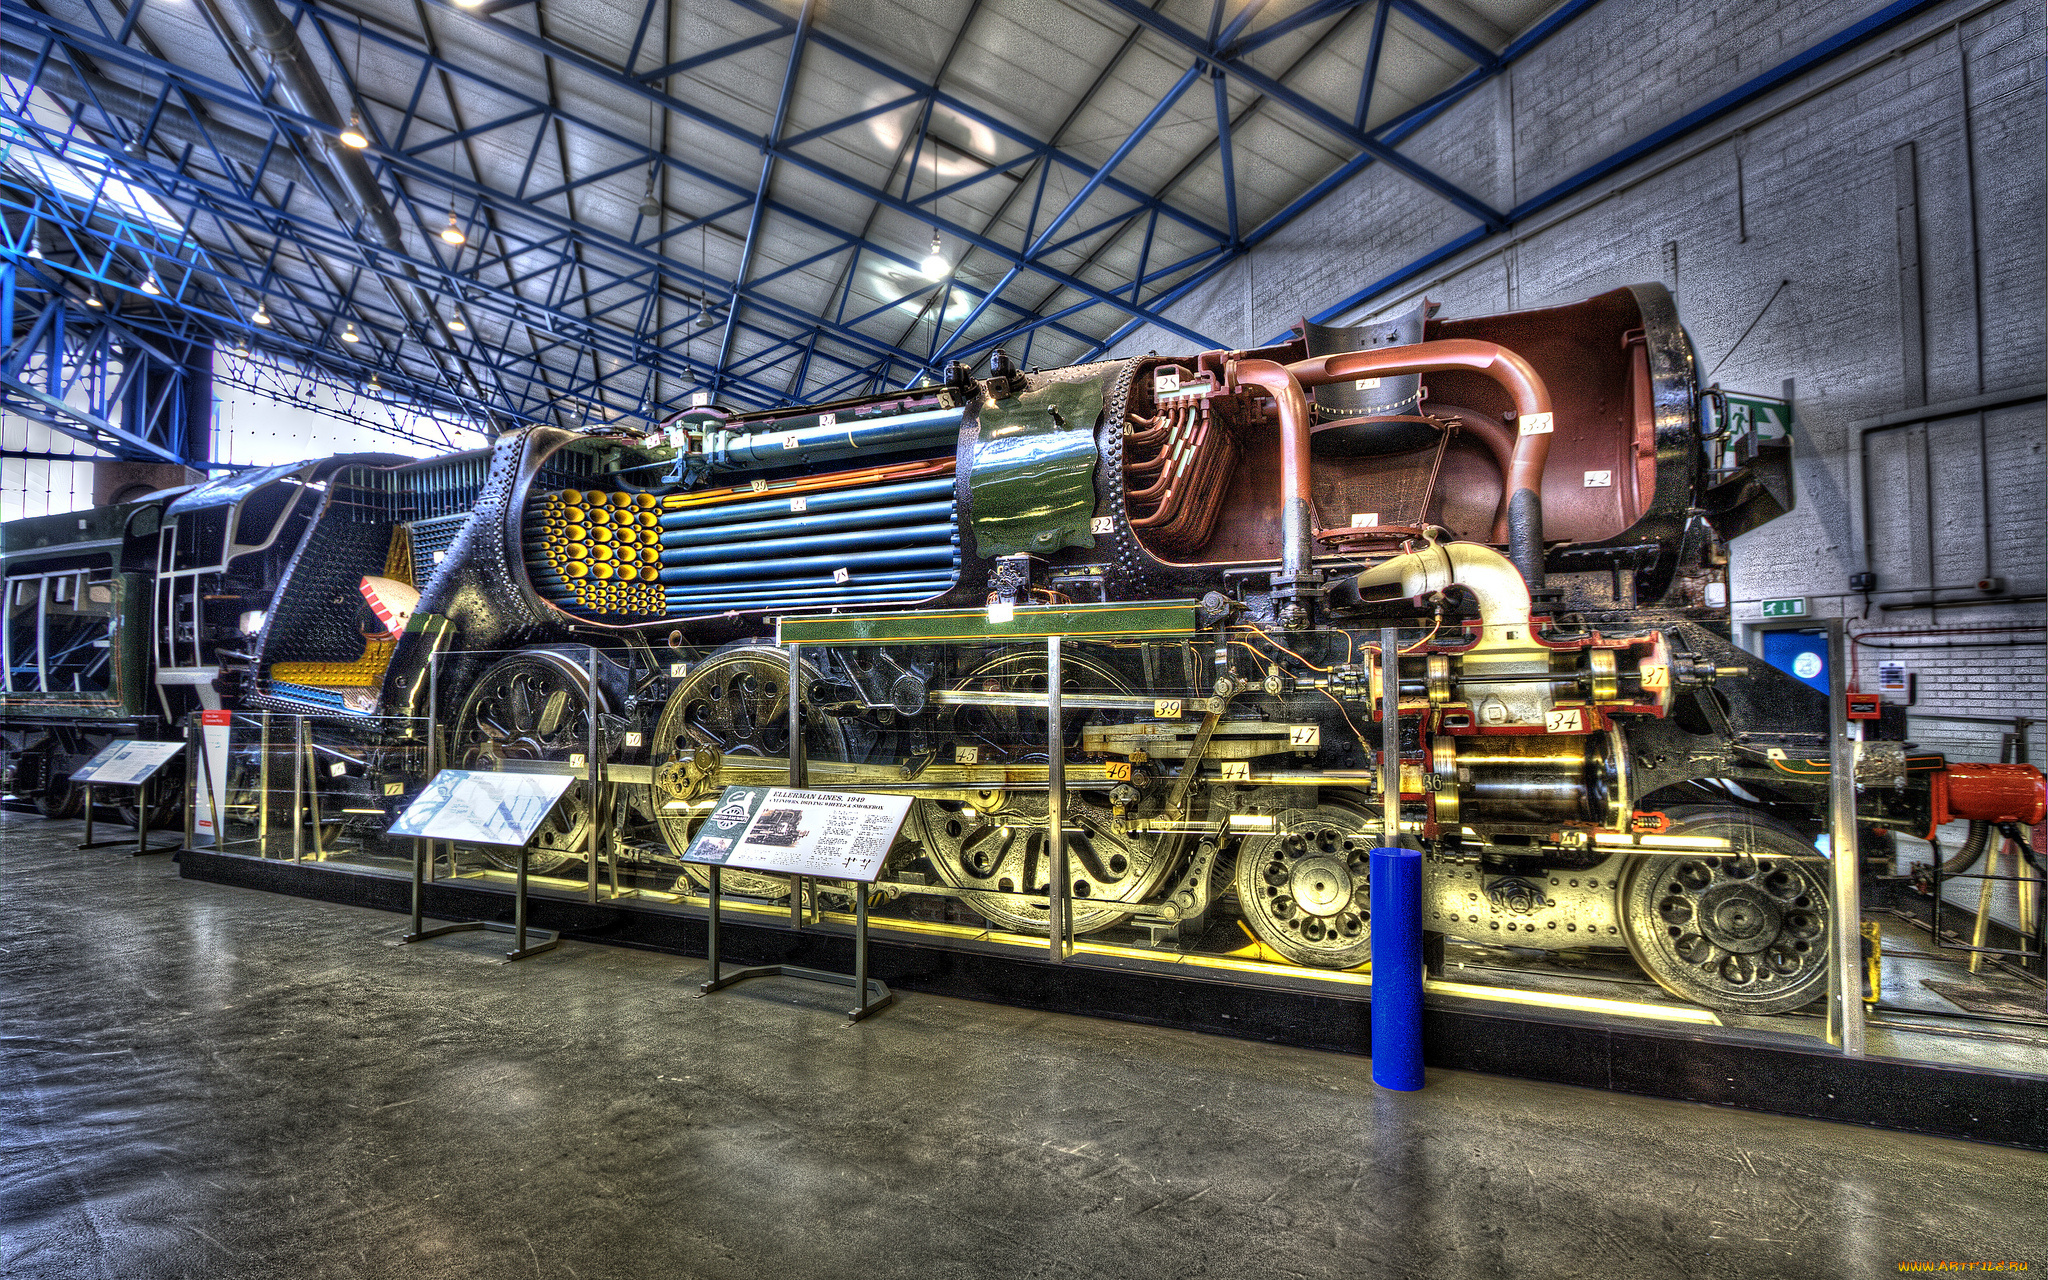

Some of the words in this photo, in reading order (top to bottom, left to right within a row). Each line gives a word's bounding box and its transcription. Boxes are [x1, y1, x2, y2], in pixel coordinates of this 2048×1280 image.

[1159, 375, 1177, 389] 28
[755, 479, 767, 491] 29
[1587, 472, 1609, 485] 42
[1091, 517, 1111, 532] 32
[1643, 667, 1666, 684] 37
[1156, 699, 1179, 716] 39
[1549, 711, 1579, 730] 34
[1292, 728, 1317, 744] 47
[957, 748, 977, 761] 45
[1106, 763, 1130, 778] 46
[1222, 764, 1248, 779] 44
[1423, 774, 1442, 791] 36
[773, 791, 816, 800] ELLERMAN
